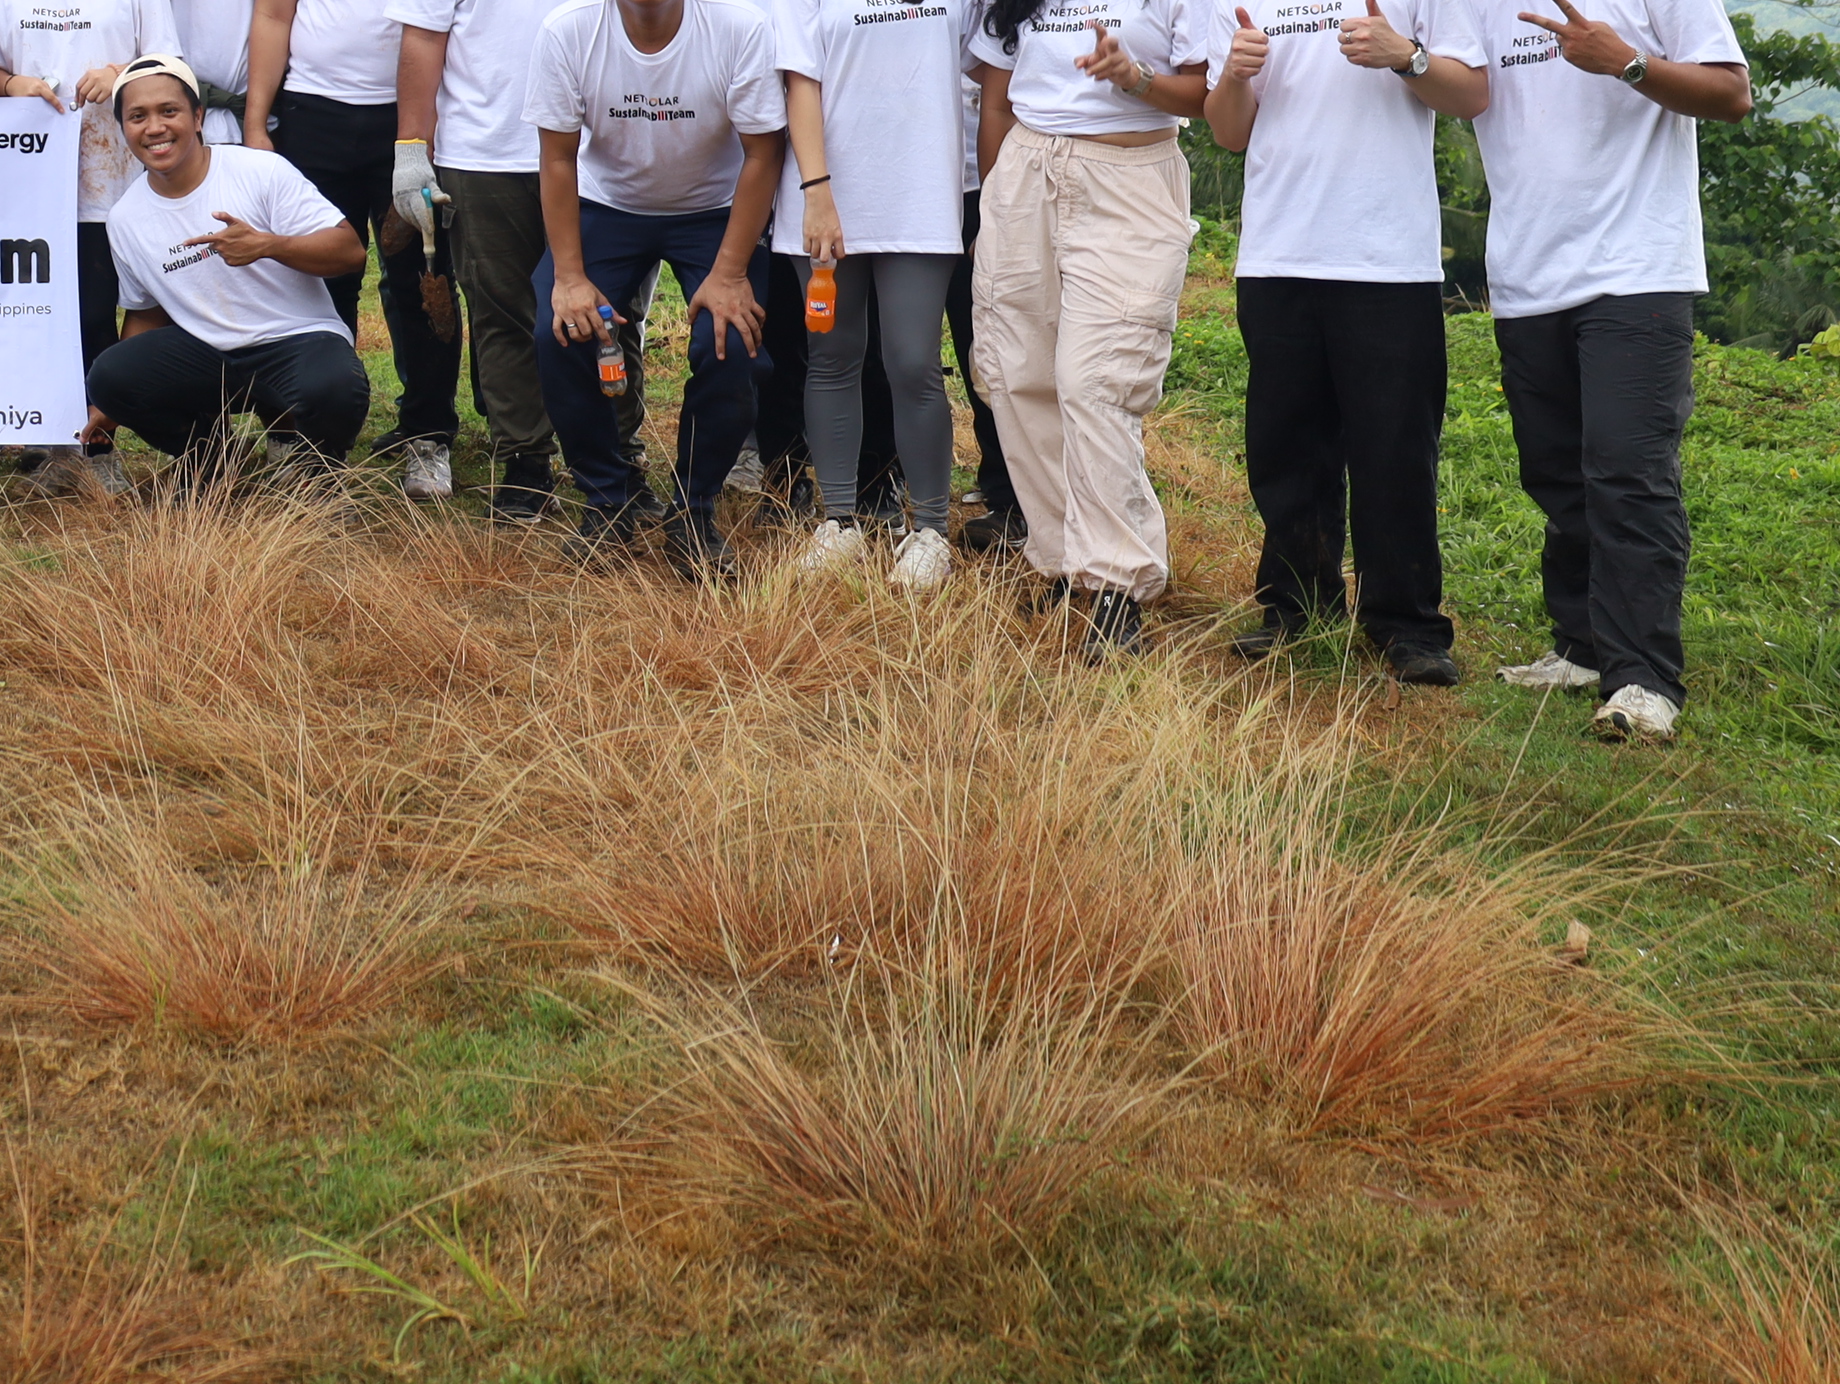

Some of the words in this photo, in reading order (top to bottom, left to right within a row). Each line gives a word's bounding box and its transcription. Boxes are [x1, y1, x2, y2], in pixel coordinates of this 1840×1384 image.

[32, 8, 81, 19] NETSOLAR
[1049, 4, 1108, 17] NETSOLAR
[1276, 2, 1342, 18] NETSOLAR
[1513, 30, 1557, 47] NETSOL
